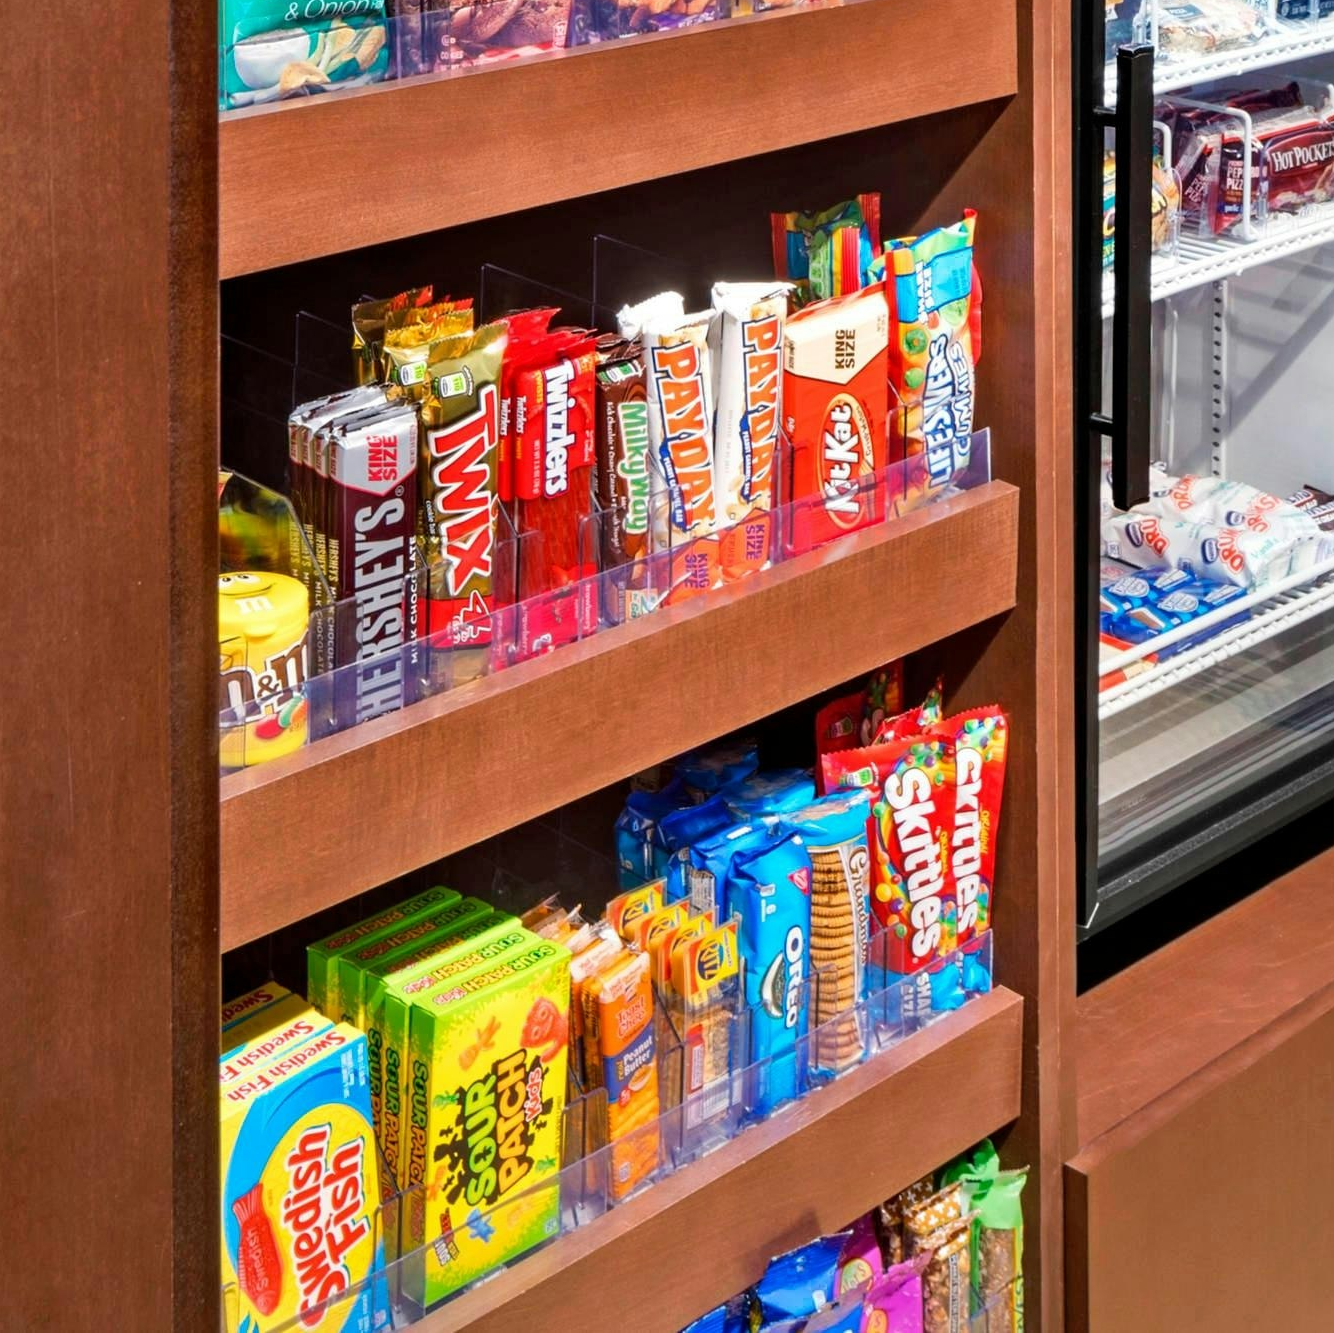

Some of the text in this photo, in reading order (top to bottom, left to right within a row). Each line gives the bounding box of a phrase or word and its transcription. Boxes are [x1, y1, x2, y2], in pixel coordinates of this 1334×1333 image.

[284, 1, 299, 22] &
[1271, 150, 1295, 172] HOT
[834, 328, 846, 369] KING
[845, 328, 856, 369] SIZE
[742, 314, 782, 502] PAYDAY
[950, 343, 972, 456] GUMMIES
[544, 358, 576, 498] Twizzlers
[651, 341, 717, 532] PAYDAY
[368, 435, 383, 481] KING
[383, 435, 398, 481] SIZE
[428, 382, 498, 596] TWIX
[745, 523, 756, 560] SIZE
[754, 523, 766, 560] KING
[697, 552, 709, 590] KING
[355, 498, 406, 722] HERSHEY'S
[409, 535, 419, 664] MILK CHOCOLATE
[884, 767, 947, 959] Skittles
[433, 954, 484, 980] PATCH
[481, 933, 524, 959] SOUR
[511, 945, 556, 971] SOUR
[463, 965, 517, 993] PATCH
[783, 926, 804, 1030] OREO
[236, 1020, 314, 1067] Swedish
[268, 1031, 347, 1078] Swedish
[368, 1027, 382, 1097] SOUR
[623, 1034, 653, 1063] Peanut
[623, 1050, 652, 1077] Butter
[227, 1074, 274, 1102] Fish
[385, 1047, 400, 1115] SOUR
[525, 1066, 544, 1122] Kids
[409, 1060, 428, 1189] SOUR PATCH
[465, 1074, 498, 1206] SOUR
[495, 1049, 528, 1195] PATCH
[282, 1126, 347, 1329] Swedish
[321, 1139, 369, 1267] Fish
[247, 1227, 269, 1291] Swedish
